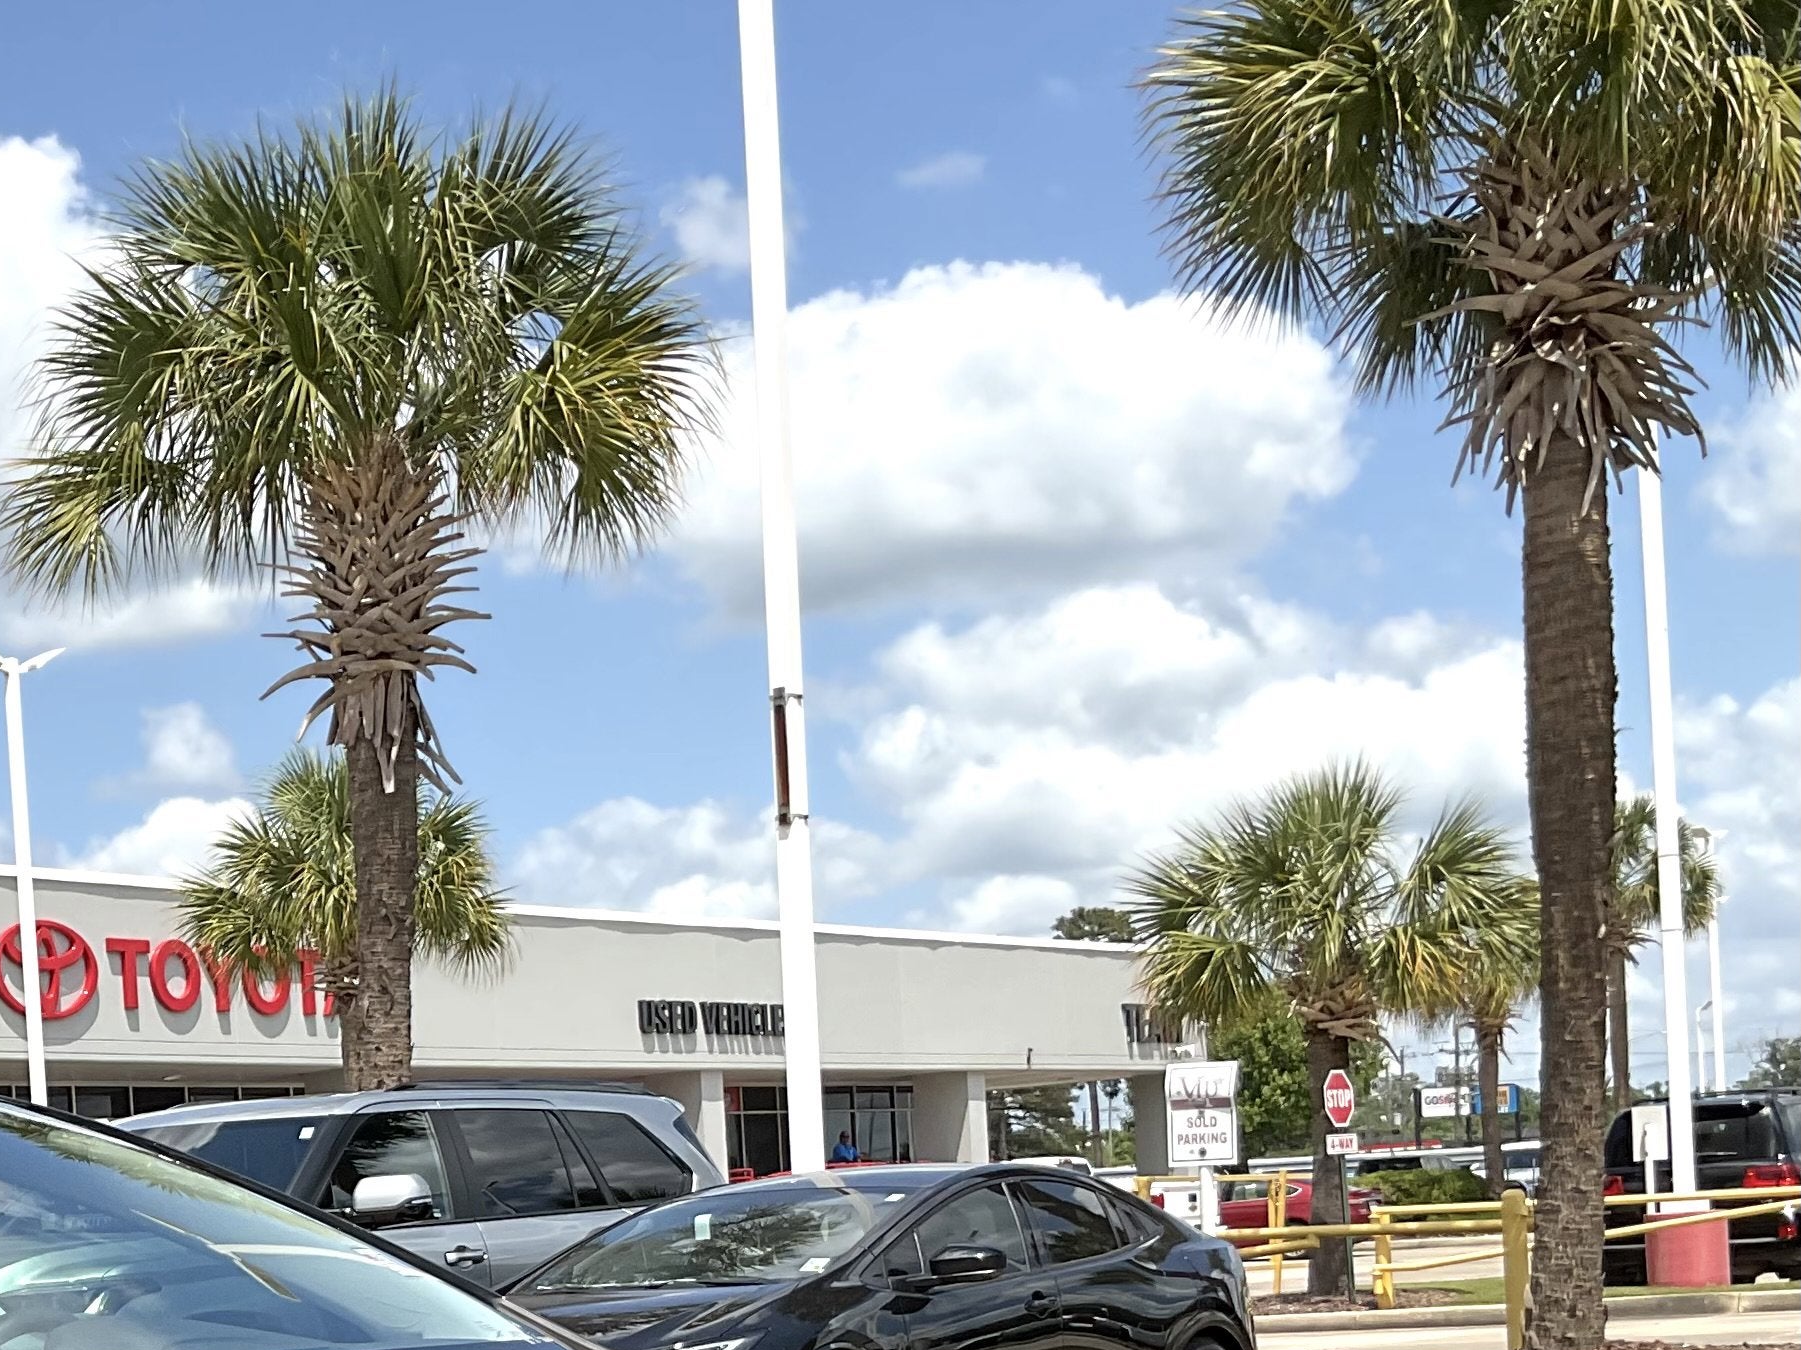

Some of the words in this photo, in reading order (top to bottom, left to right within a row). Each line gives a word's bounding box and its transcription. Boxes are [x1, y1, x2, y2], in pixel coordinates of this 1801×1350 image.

[105, 938, 338, 1016] TOYOT
[637, 999, 697, 1034] USED
[699, 1002, 785, 1036] VEHICLE
[1326, 1088, 1351, 1108] STOP
[1187, 1116, 1217, 1129] SOLD
[1177, 1132, 1228, 1145] PARKING
[1330, 1138, 1354, 1151] 4-WAY
